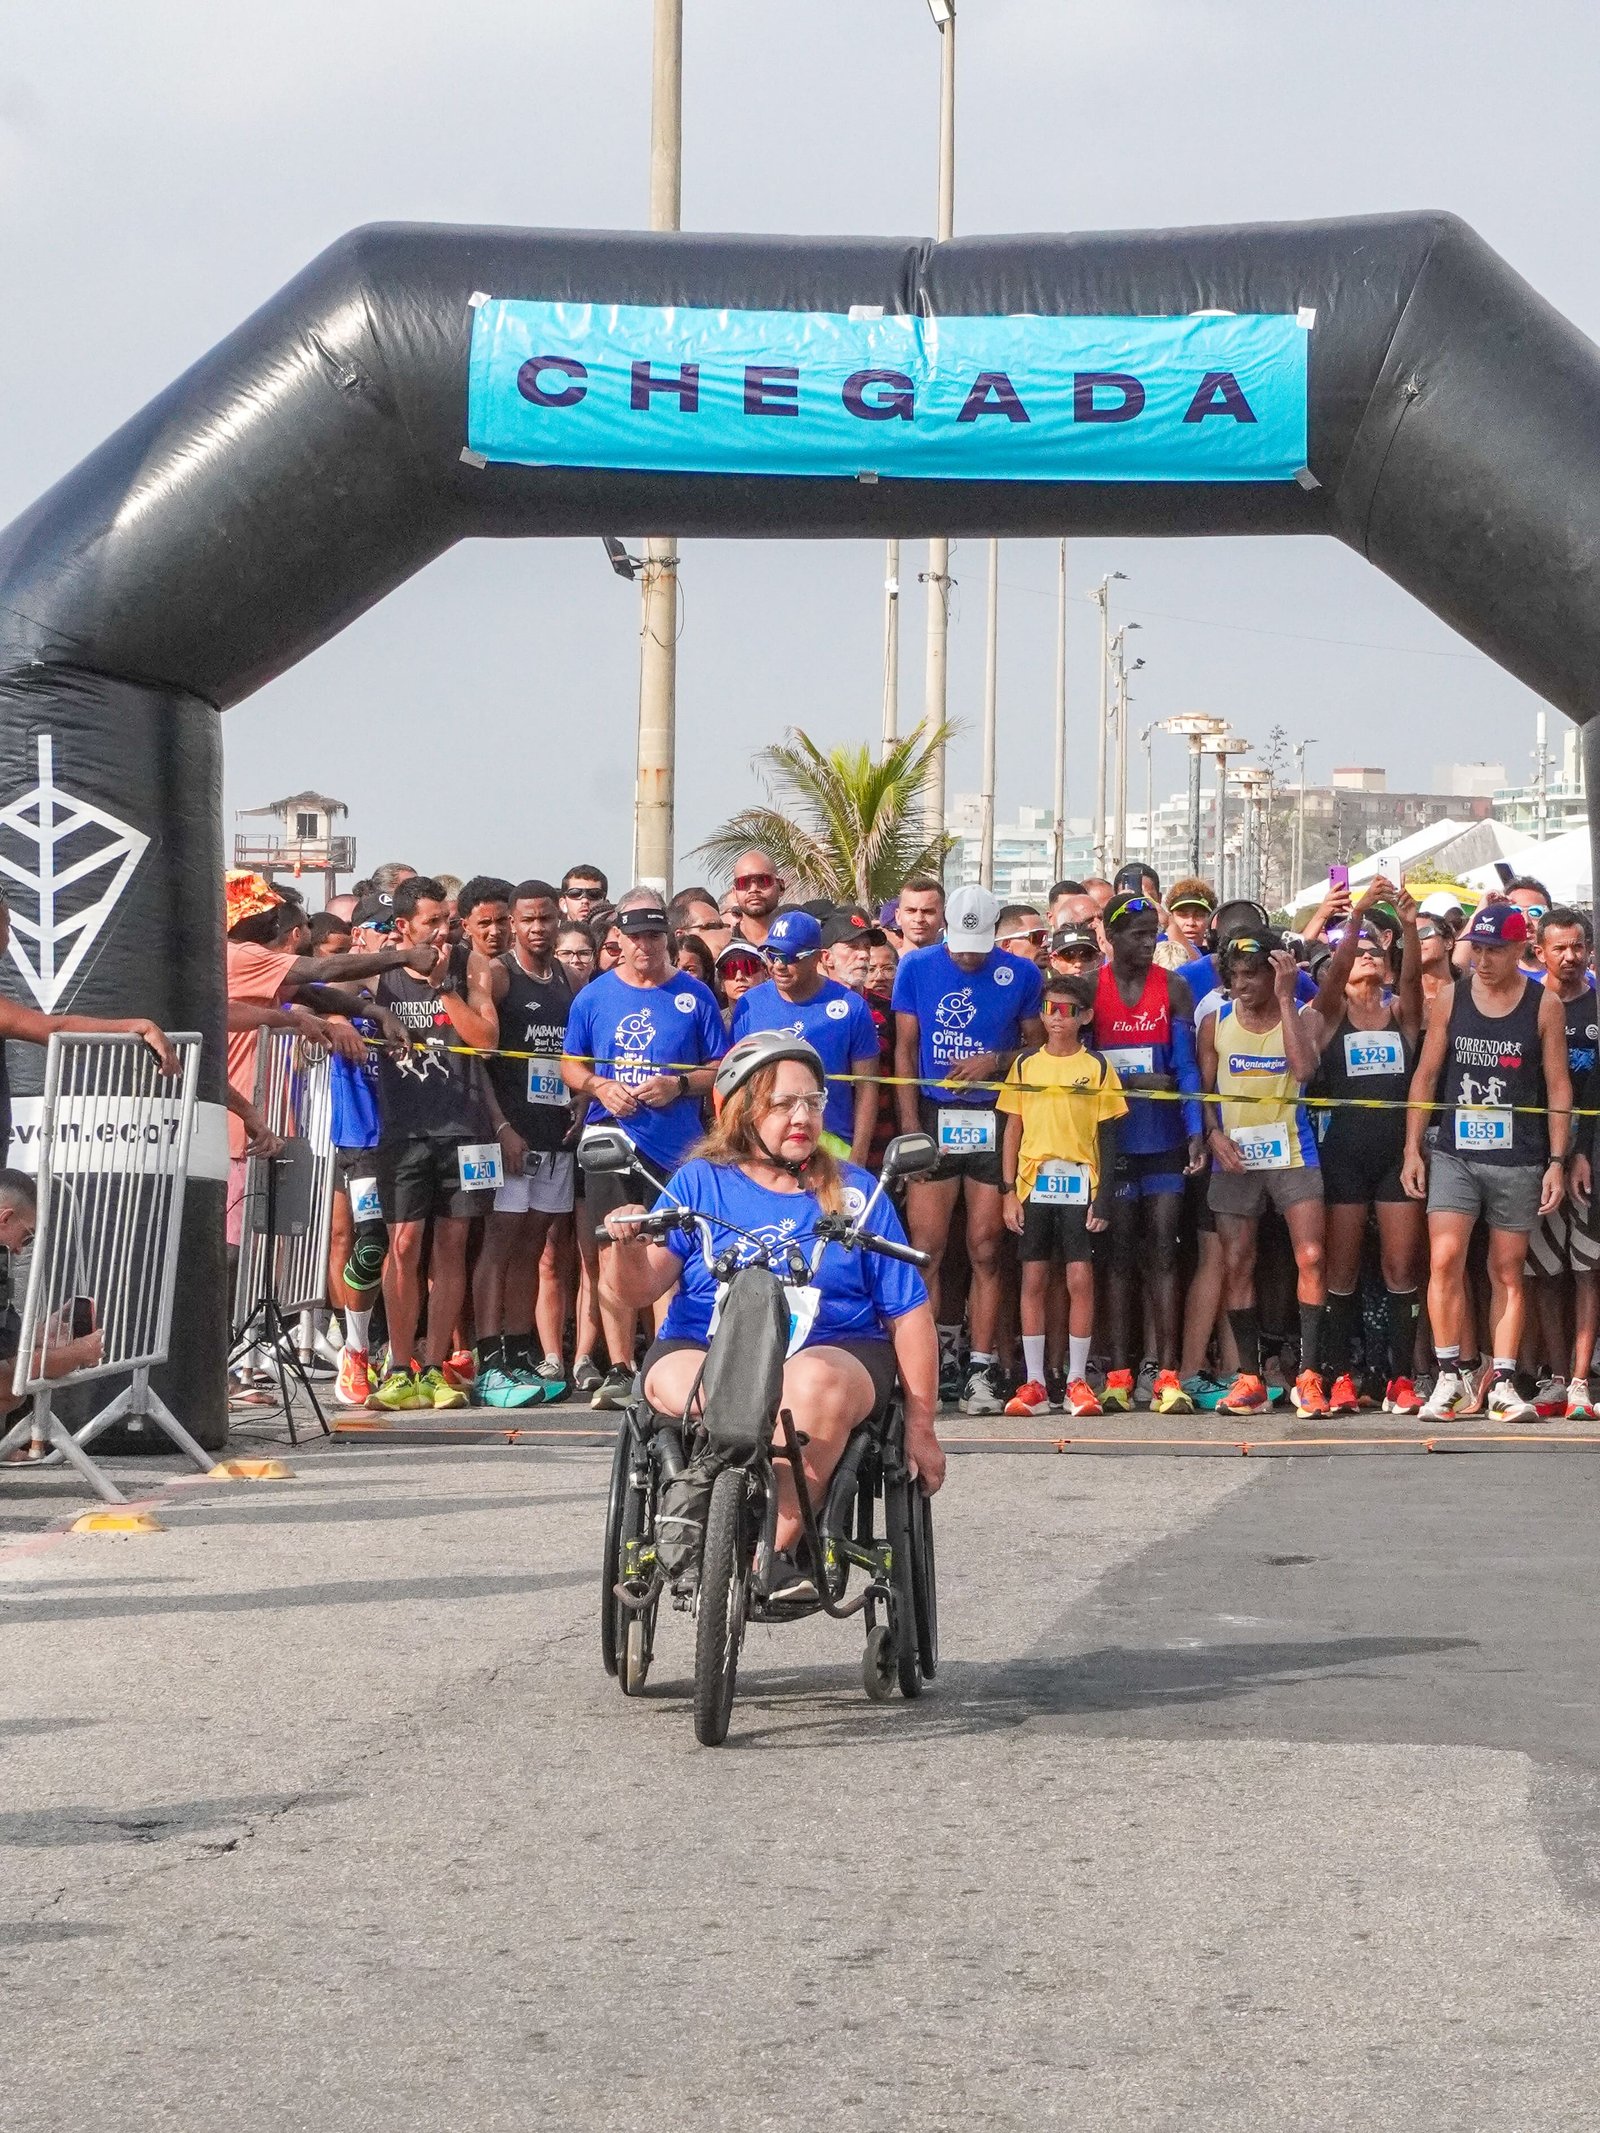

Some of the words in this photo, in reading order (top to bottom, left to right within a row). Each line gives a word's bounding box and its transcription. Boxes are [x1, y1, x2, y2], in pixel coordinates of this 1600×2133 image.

[516, 354, 1258, 424] CHEGADA
[932, 1031, 972, 1047] Onda
[1455, 1035, 1506, 1055] CORRENDO
[1358, 1047, 1388, 1064] 329
[540, 1077, 559, 1094] 621
[950, 1128, 980, 1144] 456
[1467, 1122, 1496, 1138] 859
[1244, 1142, 1275, 1160] 662
[471, 1162, 492, 1179] 750
[1047, 1176, 1070, 1192] 611
